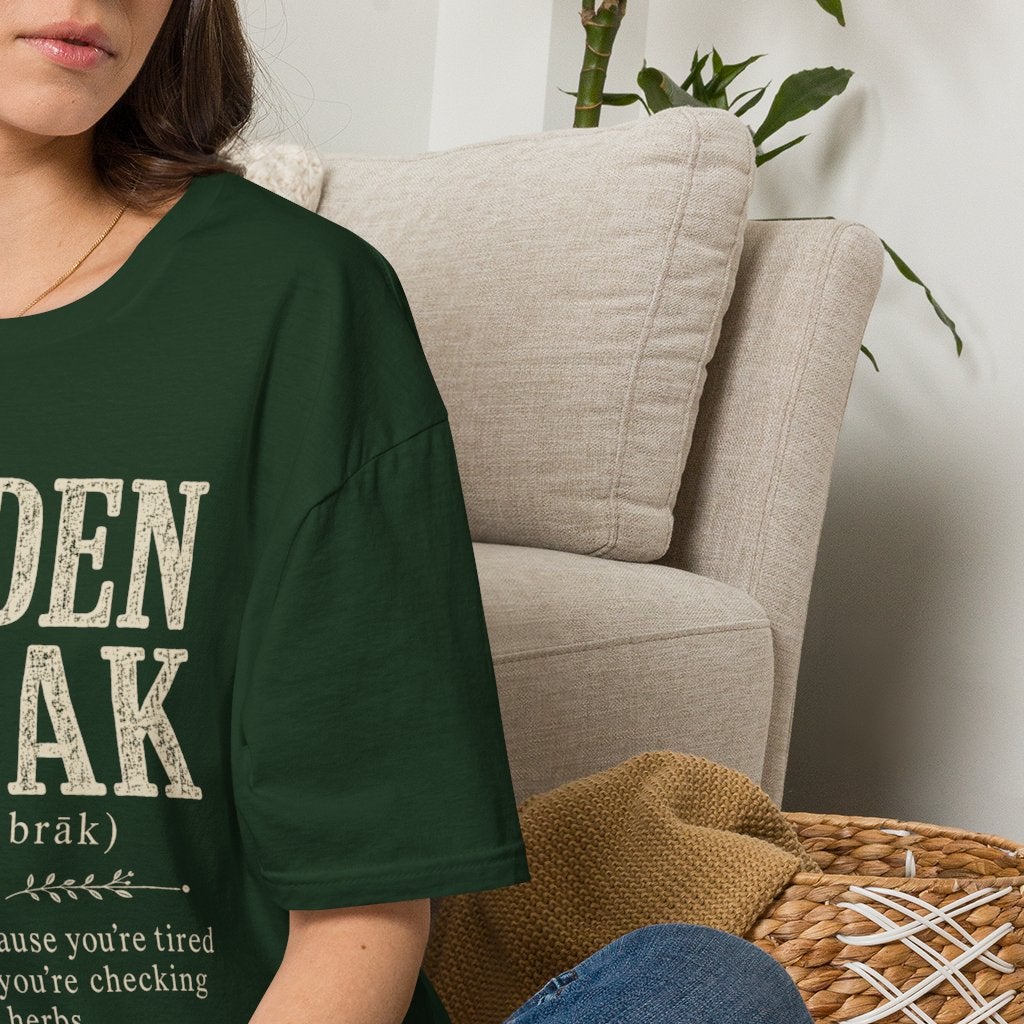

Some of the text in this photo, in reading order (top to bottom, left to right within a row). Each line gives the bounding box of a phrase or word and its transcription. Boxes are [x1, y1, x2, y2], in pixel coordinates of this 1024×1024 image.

[64, 923, 147, 961] you're
[153, 924, 215, 954] tired
[90, 963, 208, 1000] checking
